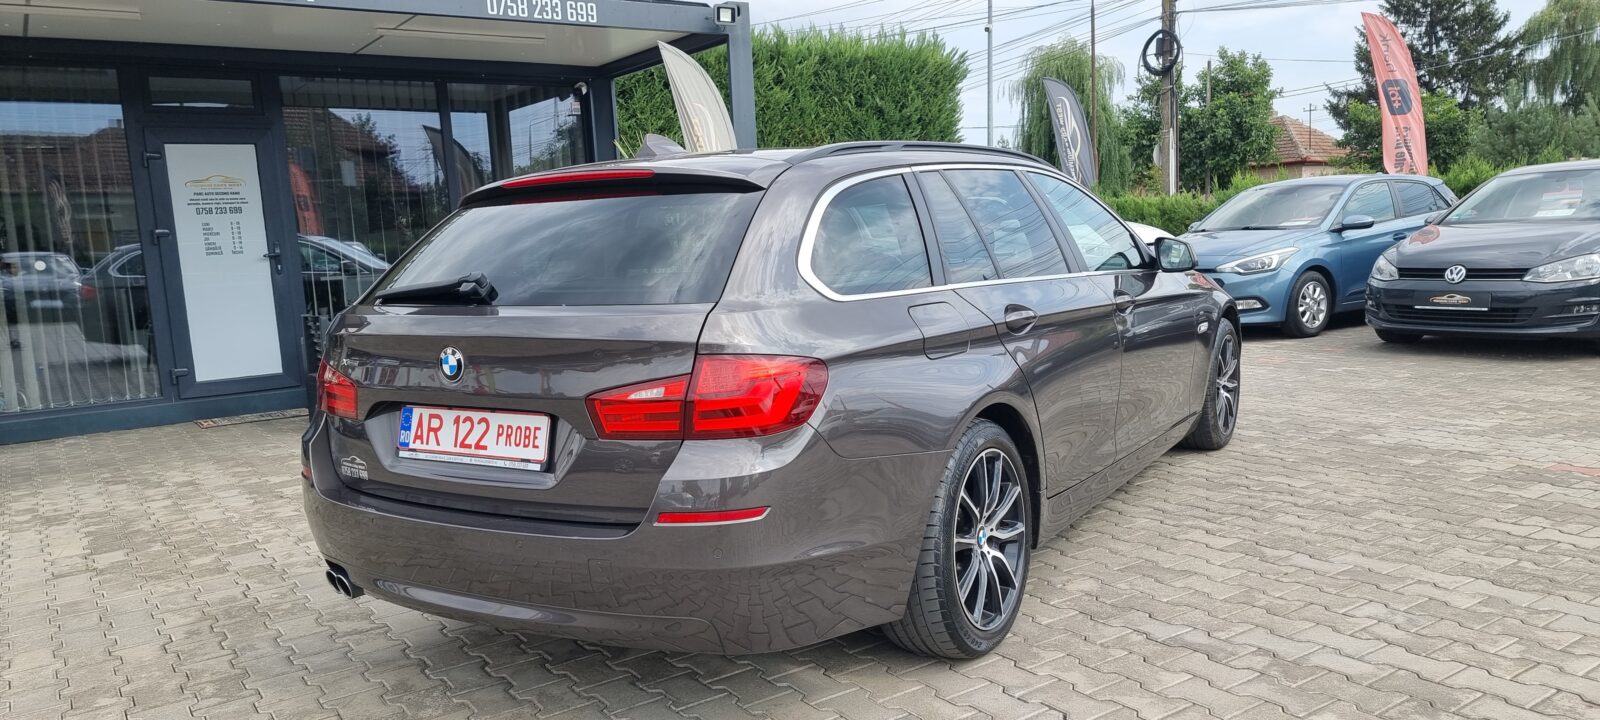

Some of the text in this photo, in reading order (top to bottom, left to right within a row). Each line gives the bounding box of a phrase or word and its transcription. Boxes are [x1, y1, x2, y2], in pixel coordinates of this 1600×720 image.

[487, 0, 598, 23] 0758 233 699
[195, 207, 214, 215] 0758
[228, 206, 243, 214] 699
[400, 430, 410, 443] RO
[412, 412, 542, 450] AR 122 PROBE
